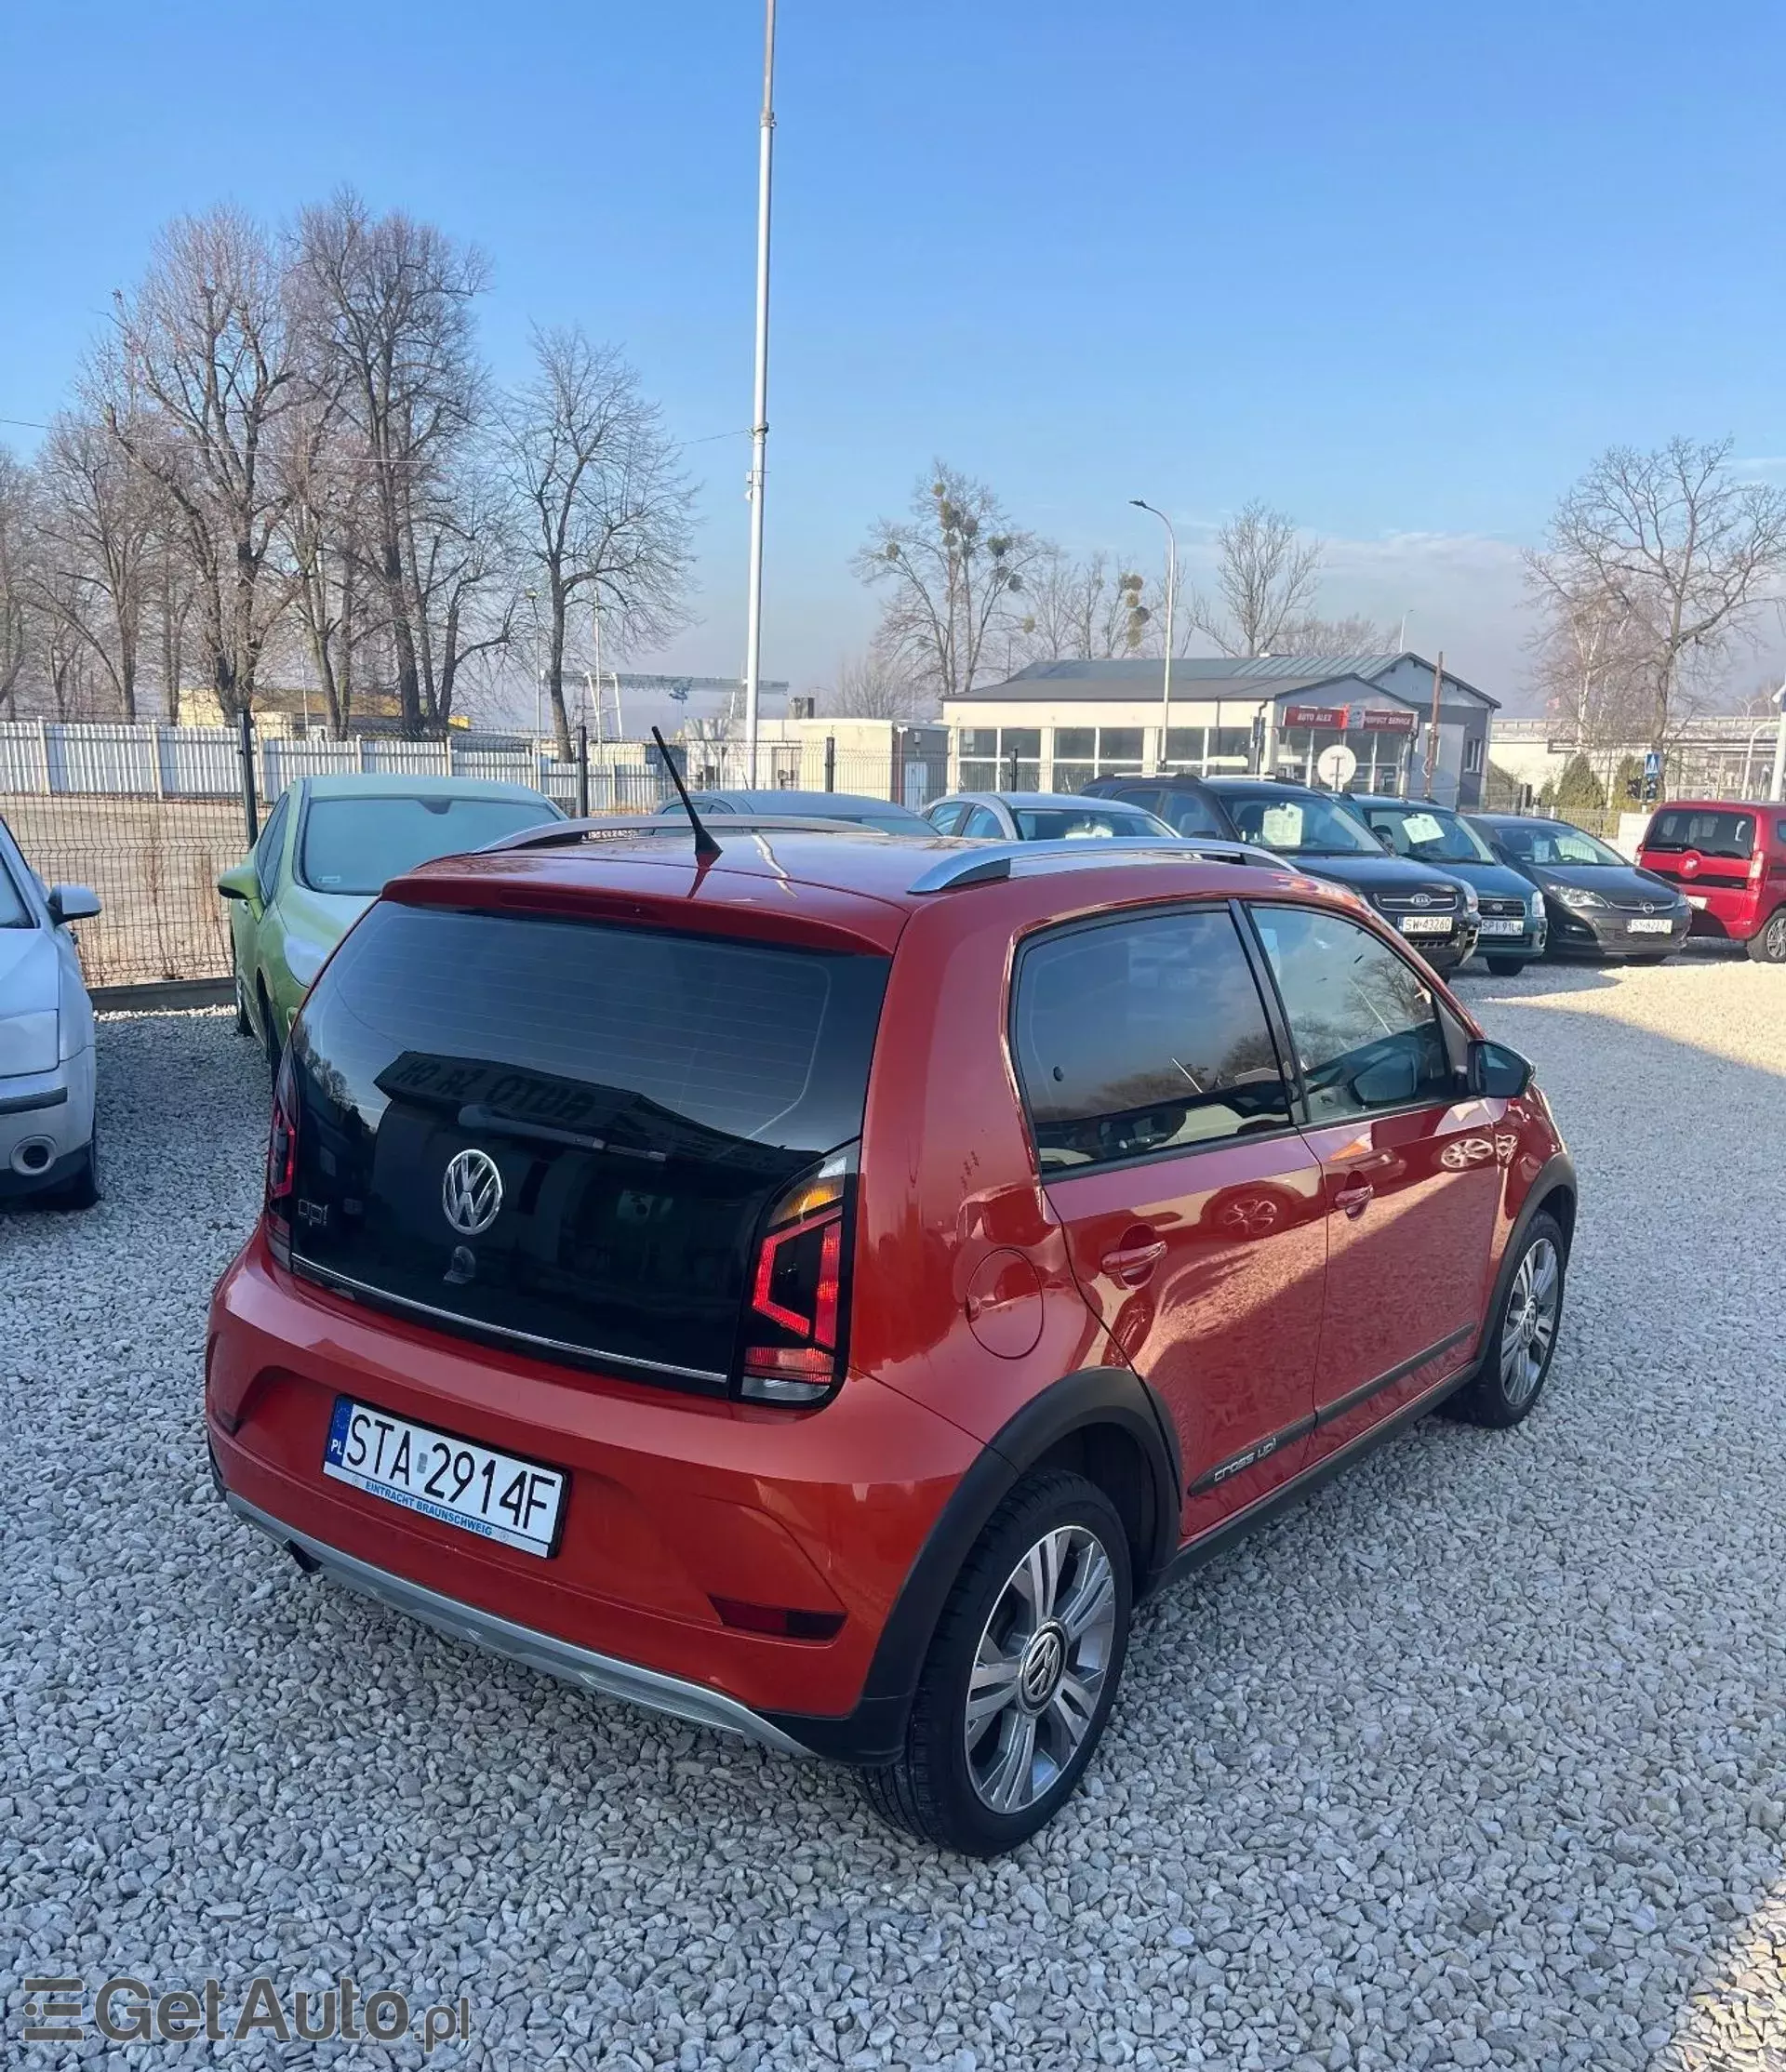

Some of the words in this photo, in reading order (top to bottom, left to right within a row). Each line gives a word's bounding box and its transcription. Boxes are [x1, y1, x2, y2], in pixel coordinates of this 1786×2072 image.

[1297, 713, 1314, 722] AUTO
[1316, 713, 1332, 722] ALEX
[330, 1439, 342, 1455] PL
[1214, 1452, 1256, 1482] cross
[1257, 1437, 1276, 1459] up!
[346, 1414, 410, 1485] STA
[423, 1441, 556, 1529] 2914F
[365, 1481, 415, 1508] EINTRACHT
[416, 1500, 493, 1537] BRAUNSCHWEIG
